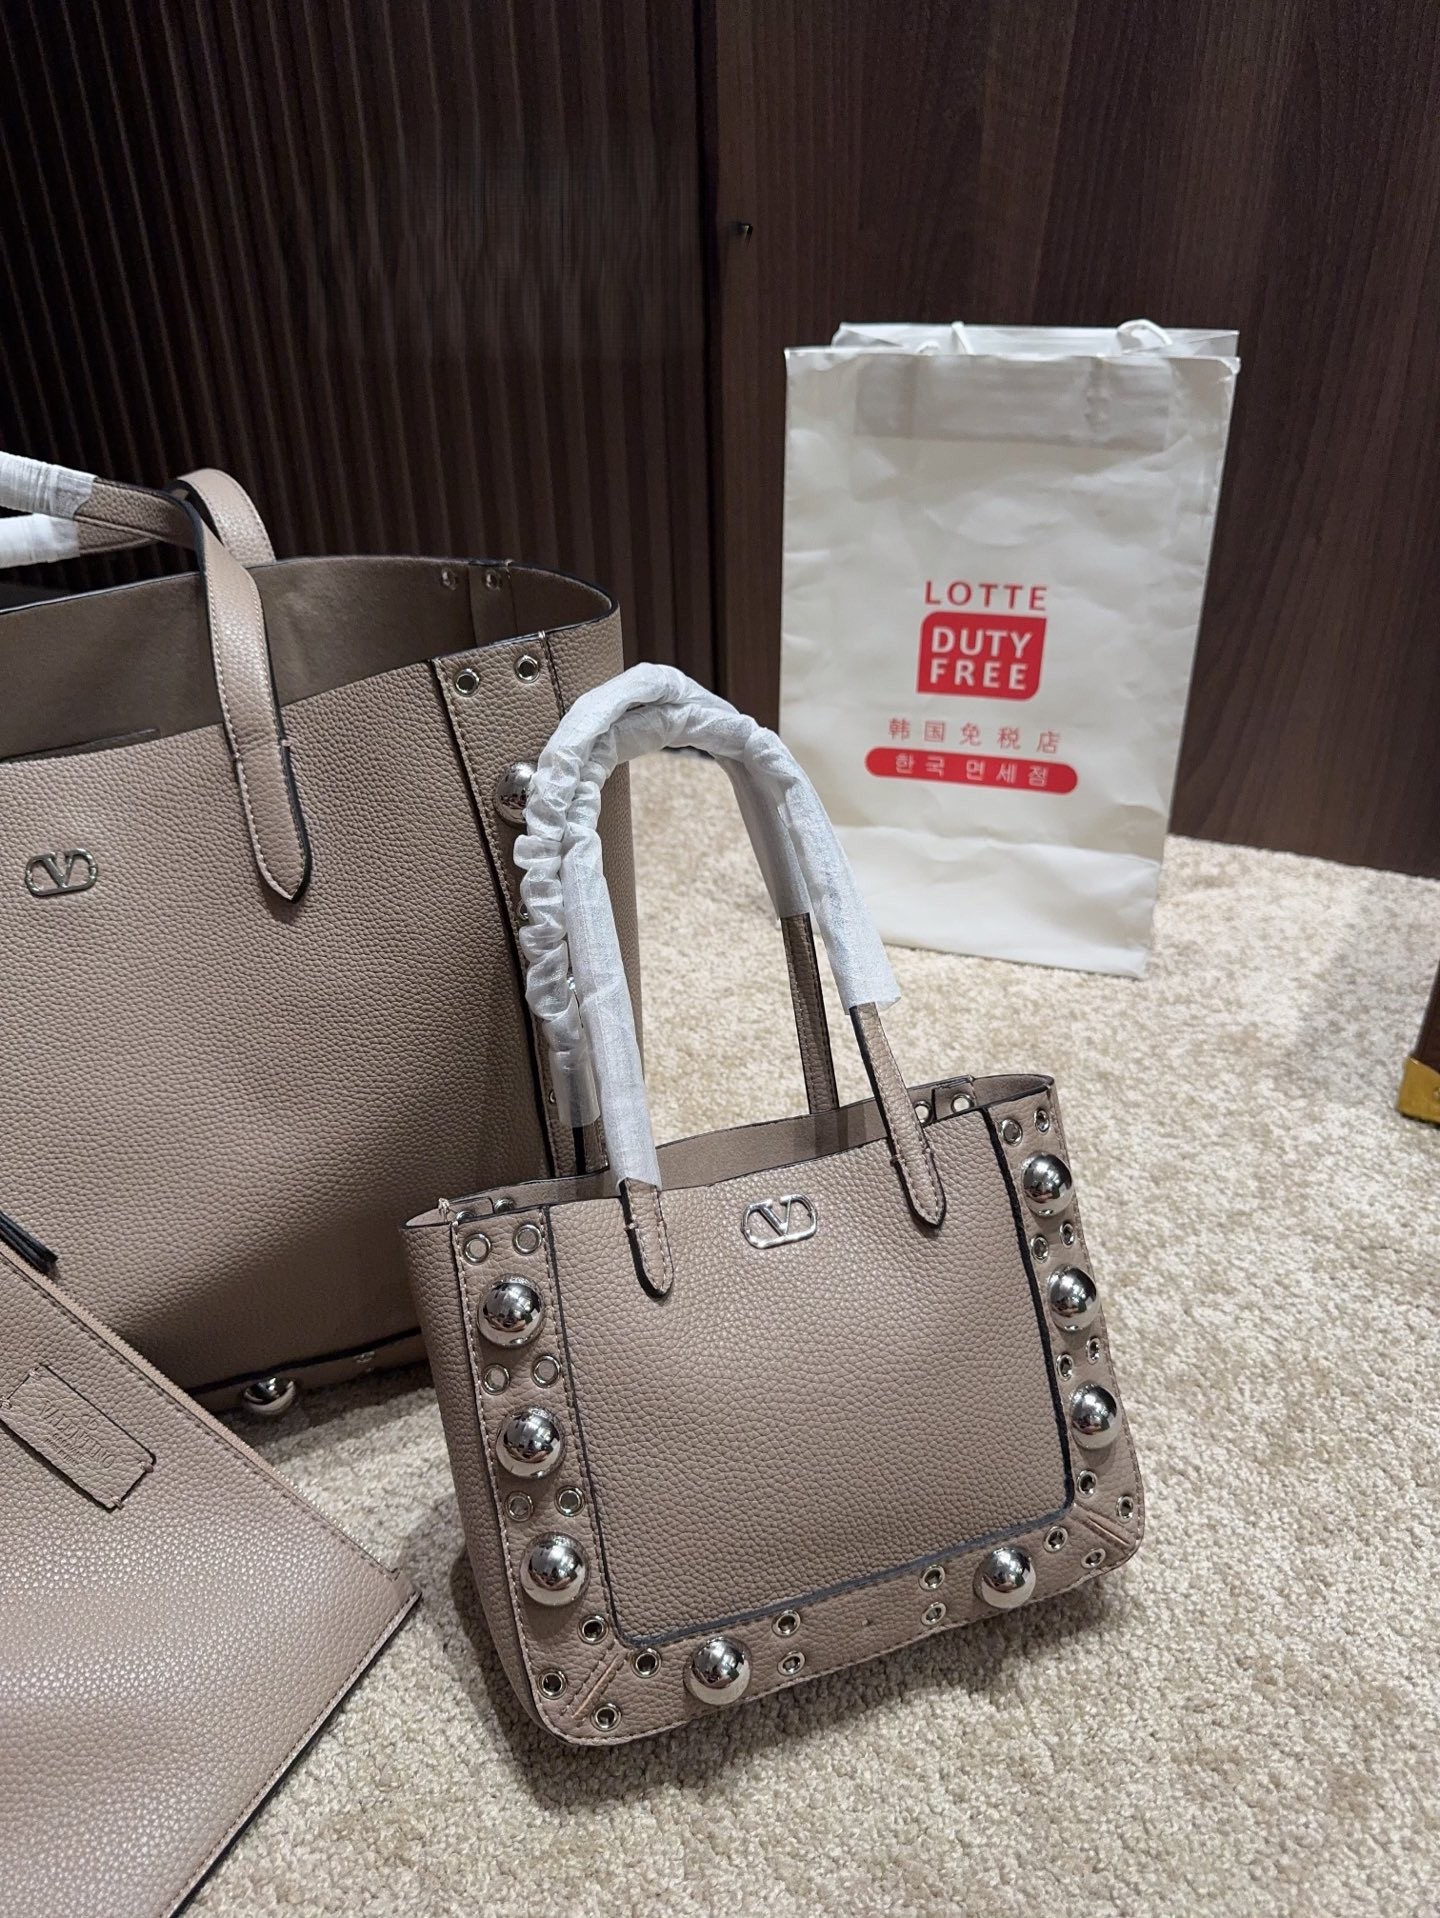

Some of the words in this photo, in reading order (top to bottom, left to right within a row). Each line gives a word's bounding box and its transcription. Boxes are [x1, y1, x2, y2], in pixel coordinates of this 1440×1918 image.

[924, 580, 1047, 611] LOTTE
[931, 626, 1032, 658] DUTY
[930, 658, 1028, 690] FREE
[888, 717, 1060, 754] 韩国免税店
[895, 753, 945, 776] 한국
[966, 759, 1049, 787] 면세점
[41, 1400, 114, 1469] VALENTINO
